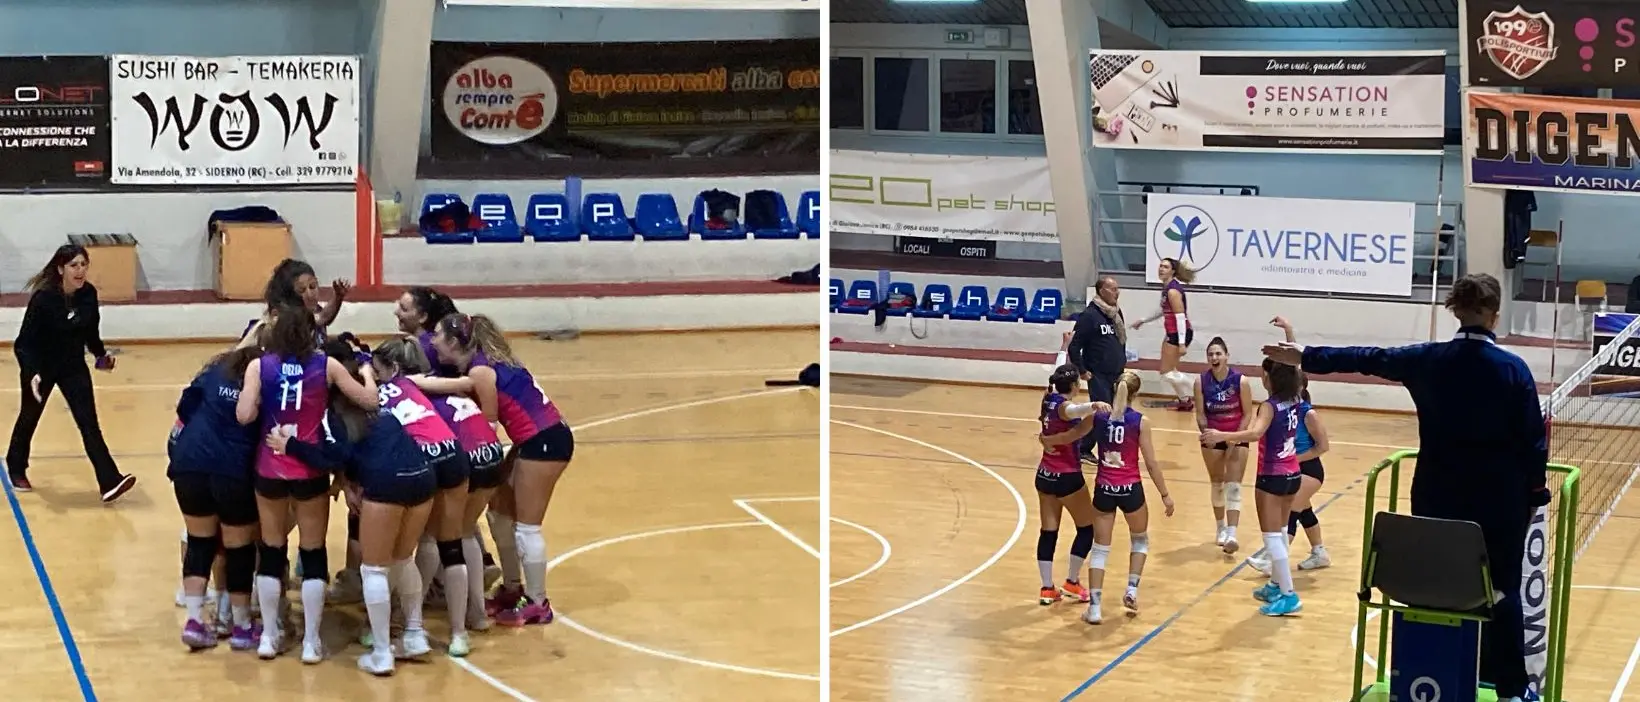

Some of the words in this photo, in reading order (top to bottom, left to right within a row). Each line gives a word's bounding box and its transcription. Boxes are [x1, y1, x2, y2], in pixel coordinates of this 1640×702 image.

[117, 61, 176, 80] SUSHI
[183, 61, 219, 81] BAR
[246, 61, 353, 81] TEMAKERIA
[1264, 59, 1290, 71] Dove
[1312, 59, 1347, 75] quando
[1346, 60, 1368, 71] vuoi
[456, 68, 513, 90] alba
[454, 92, 515, 107] sempre
[1265, 86, 1388, 102] SENSATION
[37, 108, 95, 117] SOLUTIONS
[1265, 107, 1388, 117] PROFUMERIE
[74, 126, 97, 136] CHE
[5, 138, 20, 148] LA
[21, 137, 89, 148] DIFFERENZA
[117, 166, 134, 178] Via
[135, 166, 183, 179] Amendola,
[185, 166, 198, 177] 32
[205, 166, 246, 178] SIDERNO
[246, 166, 267, 179] (RC)
[295, 165, 314, 178] 329
[937, 193, 986, 212] pet
[903, 244, 931, 254] LOCALI
[960, 246, 988, 257] OSPITI
[1227, 229, 1406, 264] TAVERNESE
[1260, 264, 1316, 275] odontoiatria
[1326, 267, 1367, 277] medicina
[280, 379, 304, 411] 11
[1287, 409, 1299, 431] 15
[1107, 425, 1125, 444] 10
